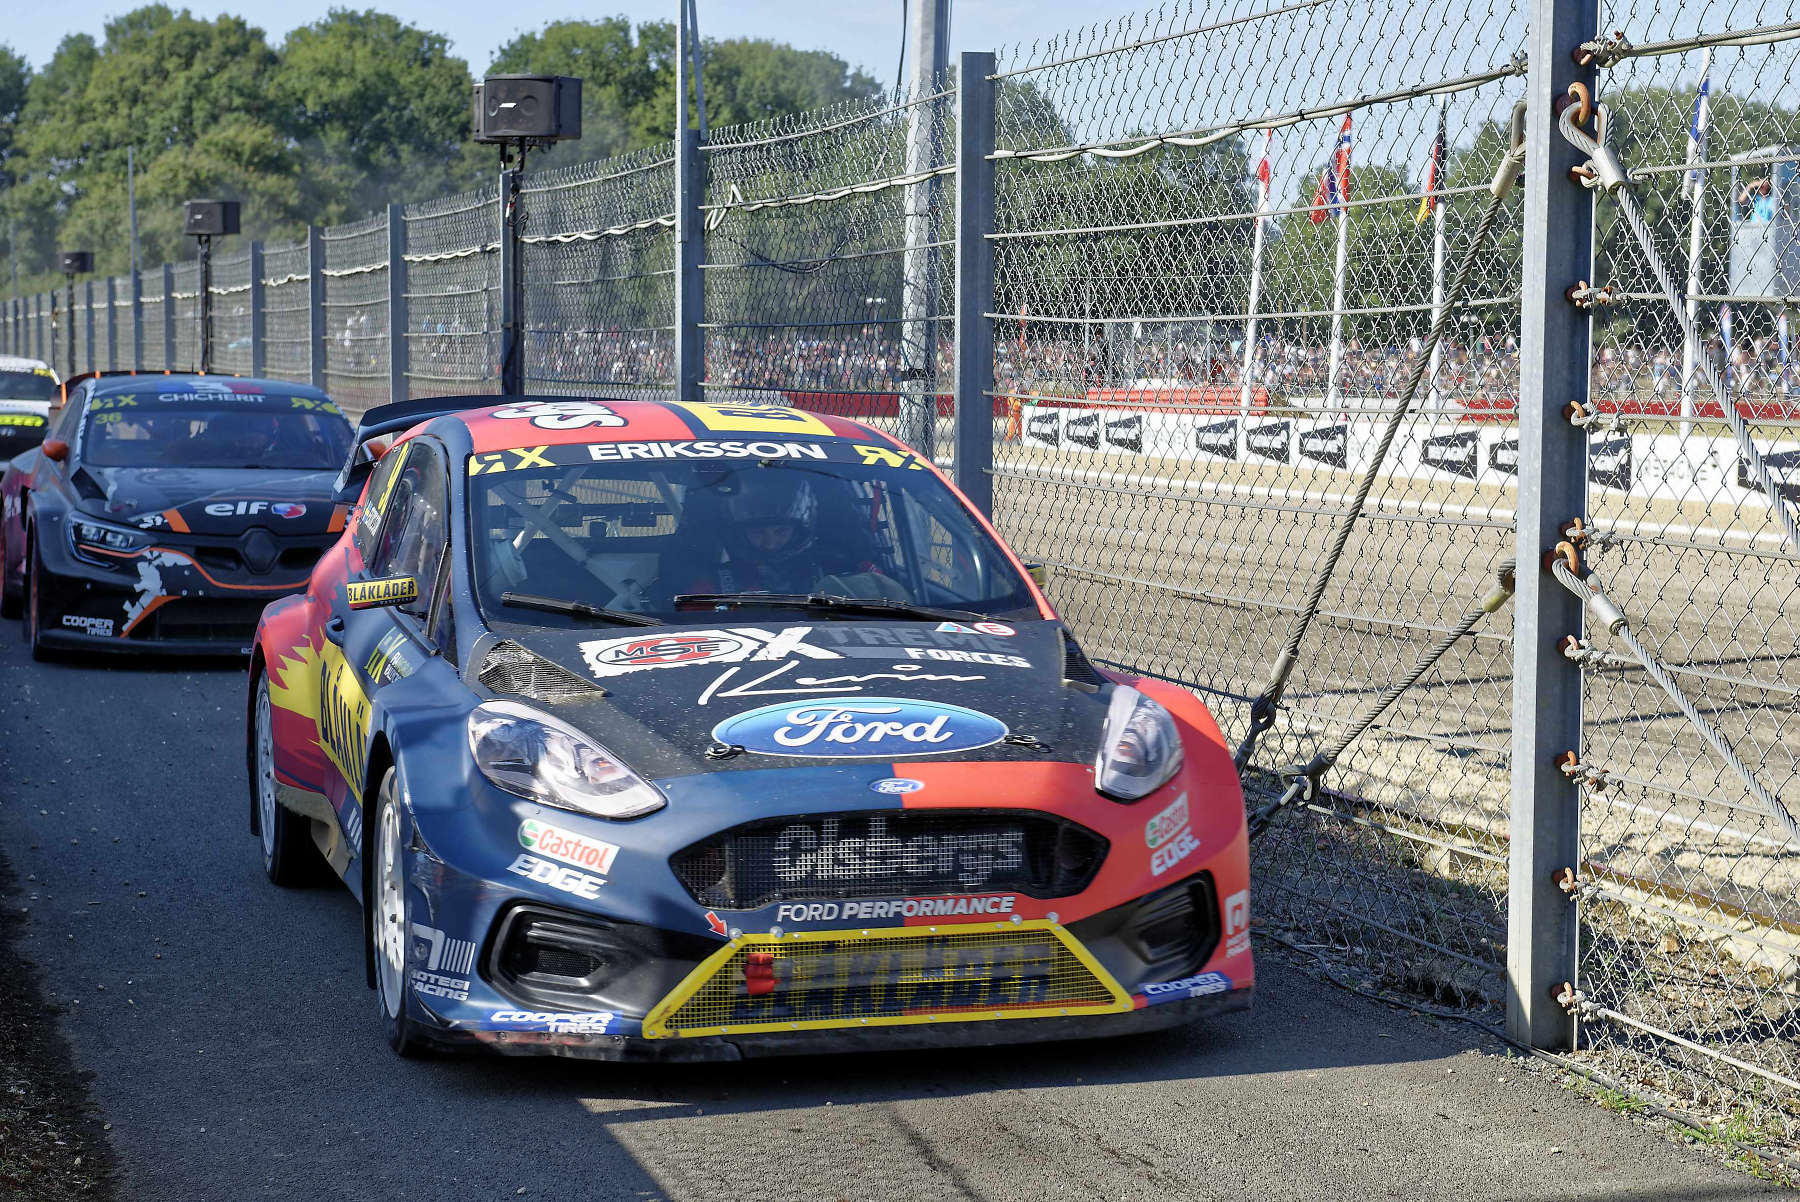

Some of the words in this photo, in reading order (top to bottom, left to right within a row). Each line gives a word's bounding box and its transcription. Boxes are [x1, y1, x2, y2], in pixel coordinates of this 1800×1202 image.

[158, 393, 267, 403] CHICHERIT
[588, 441, 829, 461] ERIKSSON
[204, 501, 269, 516] elf
[62, 615, 114, 629] COOPER
[86, 628, 113, 637] TIRES
[610, 640, 729, 663] MSE
[904, 648, 1034, 669] FORCES
[773, 706, 955, 746] Ford
[878, 781, 914, 793] Ford
[537, 827, 613, 870] Castrol
[1150, 826, 1200, 877] EDGE
[505, 853, 608, 900] EDGE
[776, 903, 839, 922] FORD
[841, 896, 1016, 919] PERFORMANCE
[1143, 971, 1224, 995] COOPER
[1188, 982, 1228, 998] TIRES
[490, 1010, 614, 1024] COOPER
[548, 1022, 608, 1035] TIRES
